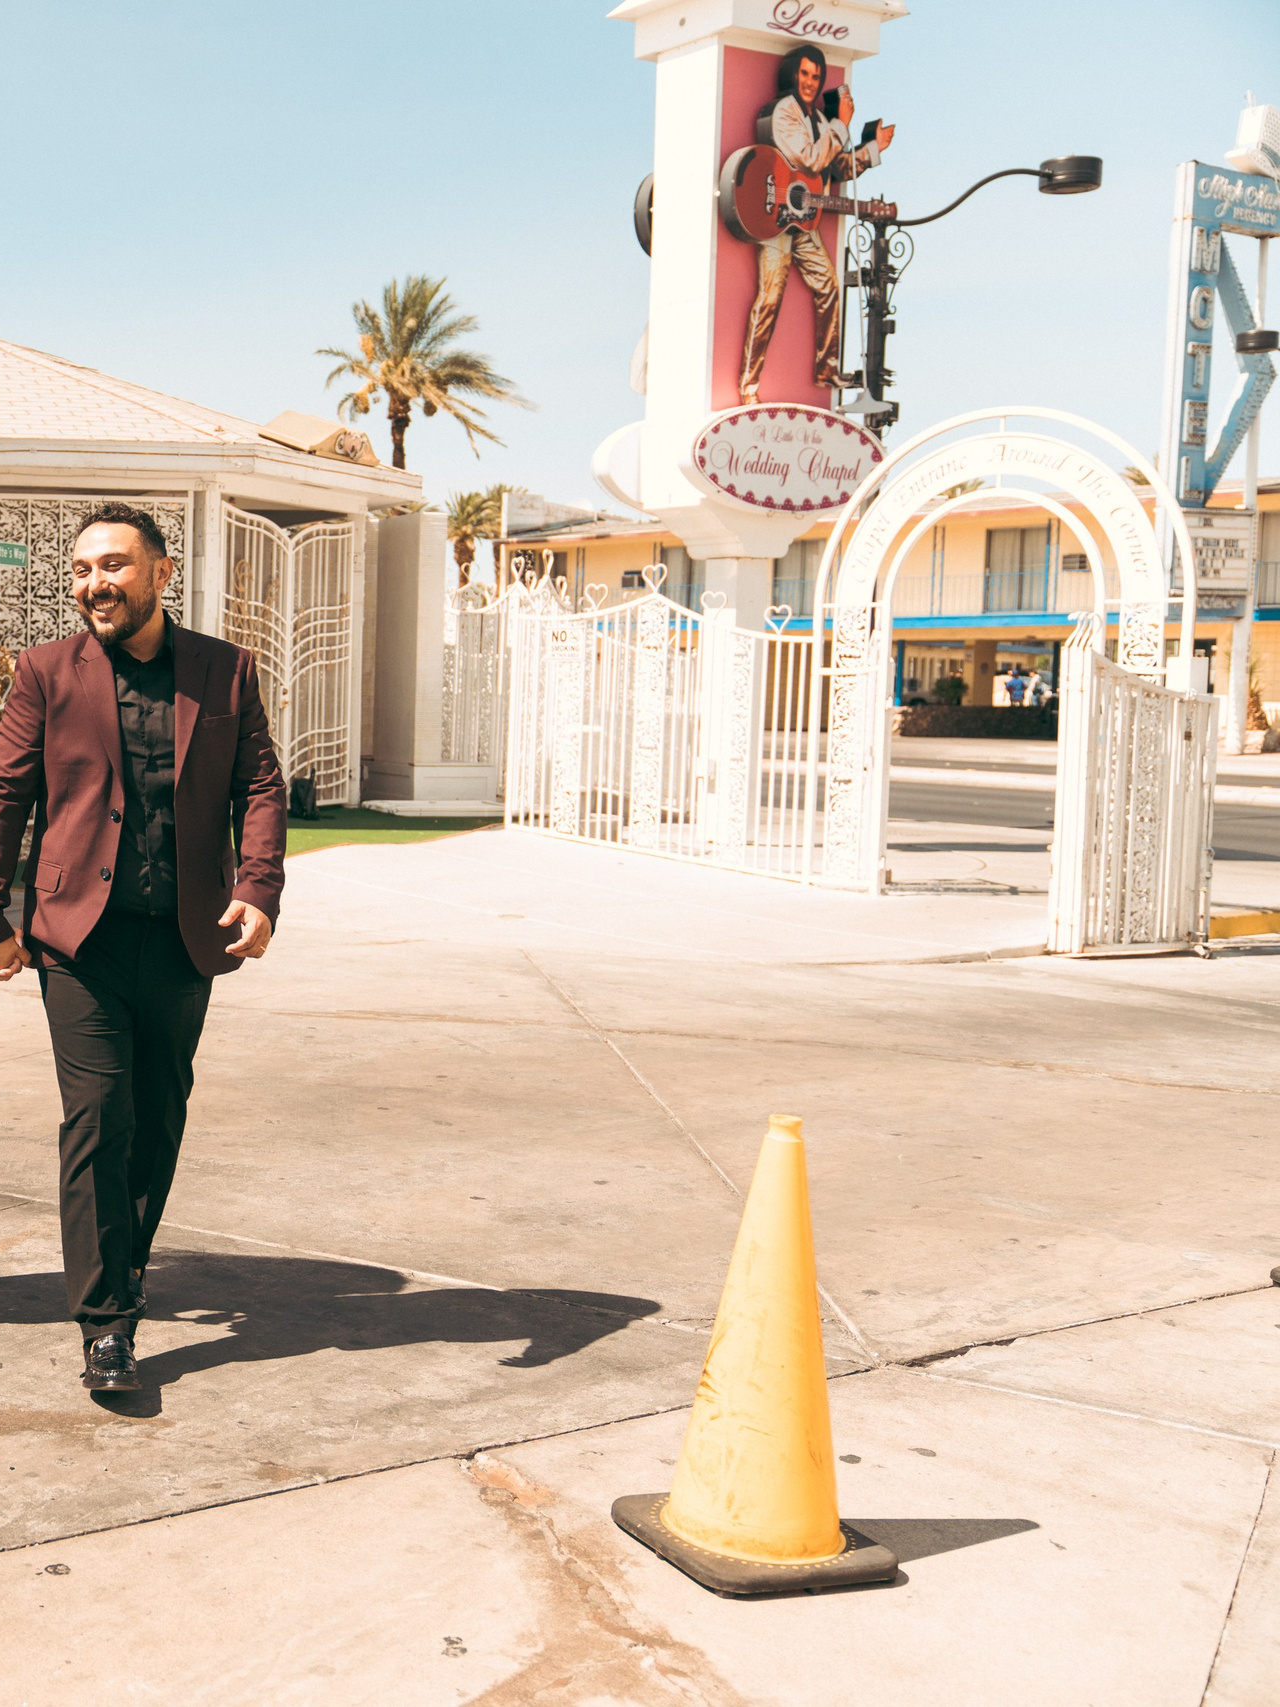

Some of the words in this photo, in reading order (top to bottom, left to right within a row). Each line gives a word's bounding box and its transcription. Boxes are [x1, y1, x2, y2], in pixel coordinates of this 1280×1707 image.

[766, 0, 849, 40] Love
[1180, 226, 1221, 500] MOTEL
[752, 424, 767, 443] A
[771, 425, 794, 444] Little
[709, 440, 790, 487] Wedding
[797, 447, 861, 490] Chapel
[987, 443, 1073, 472] Around
[1078, 464, 1112, 499] The
[1110, 506, 1149, 578] Corner
[13, 547, 26, 563] Way
[551, 630, 567, 643] NO
